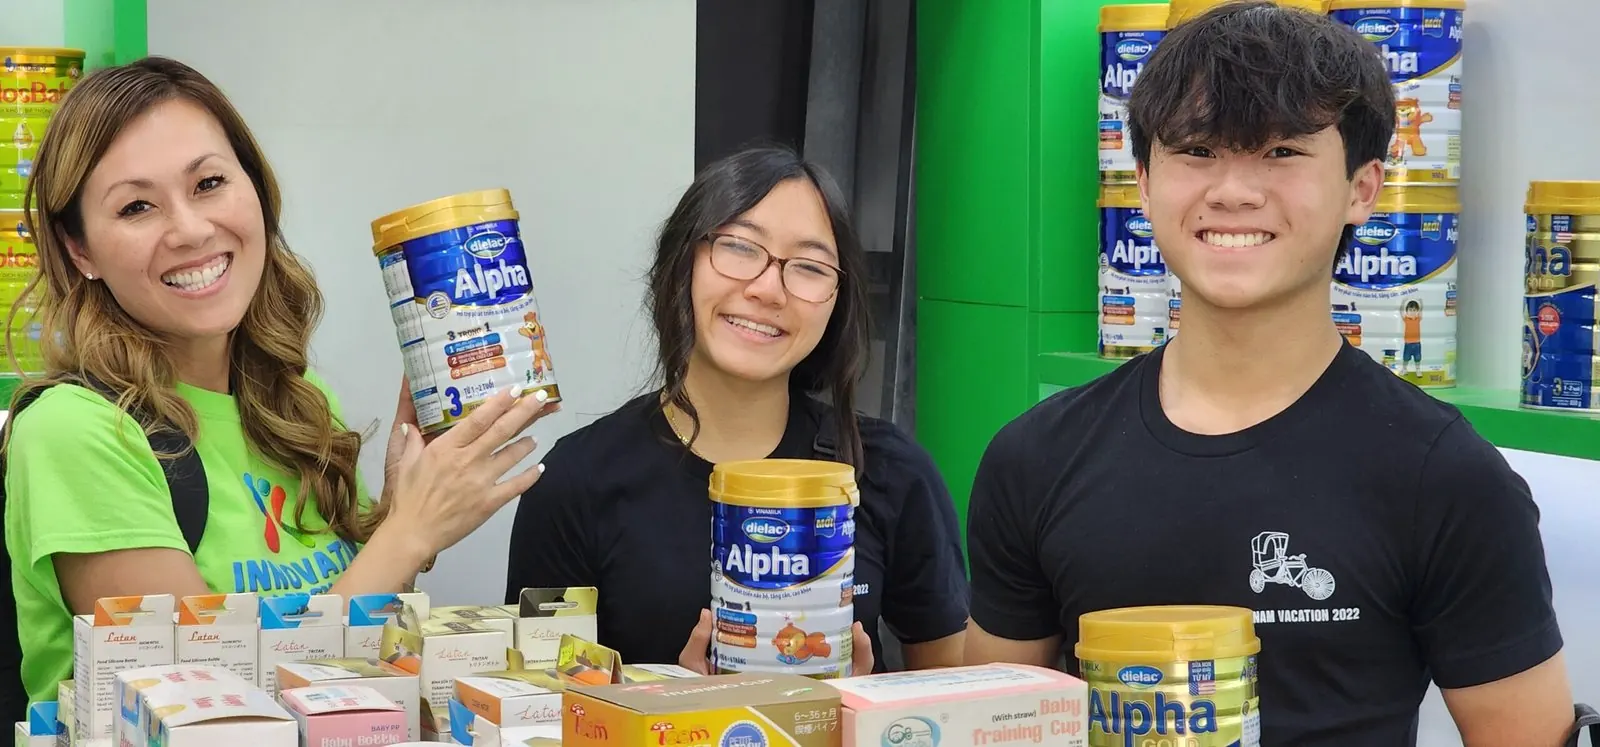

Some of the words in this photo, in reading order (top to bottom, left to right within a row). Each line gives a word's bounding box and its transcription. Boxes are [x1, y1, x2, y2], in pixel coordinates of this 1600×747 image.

[1357, 22, 1393, 34] dielac
[1355, 225, 1392, 237] dielac
[470, 238, 504, 252] dielac
[1112, 238, 1166, 270] Alph
[1335, 247, 1417, 282] Alpha
[455, 258, 529, 300] Alpha
[445, 386, 462, 417] 3
[746, 522, 783, 534] dielac
[726, 544, 809, 581] Alpha
[853, 583, 869, 595] 2022
[1277, 609, 1329, 623] VACATION
[1332, 608, 1360, 621] 2022
[104, 632, 137, 643] Latan
[188, 631, 221, 642] Latan
[1121, 670, 1159, 682] dielac
[1040, 697, 1080, 717] Baby
[992, 712, 1013, 723] (With
[1013, 709, 1036, 720] straw)
[1088, 687, 1218, 747] Alpha
[972, 724, 1042, 746] Training
[1051, 719, 1081, 736] Cup
